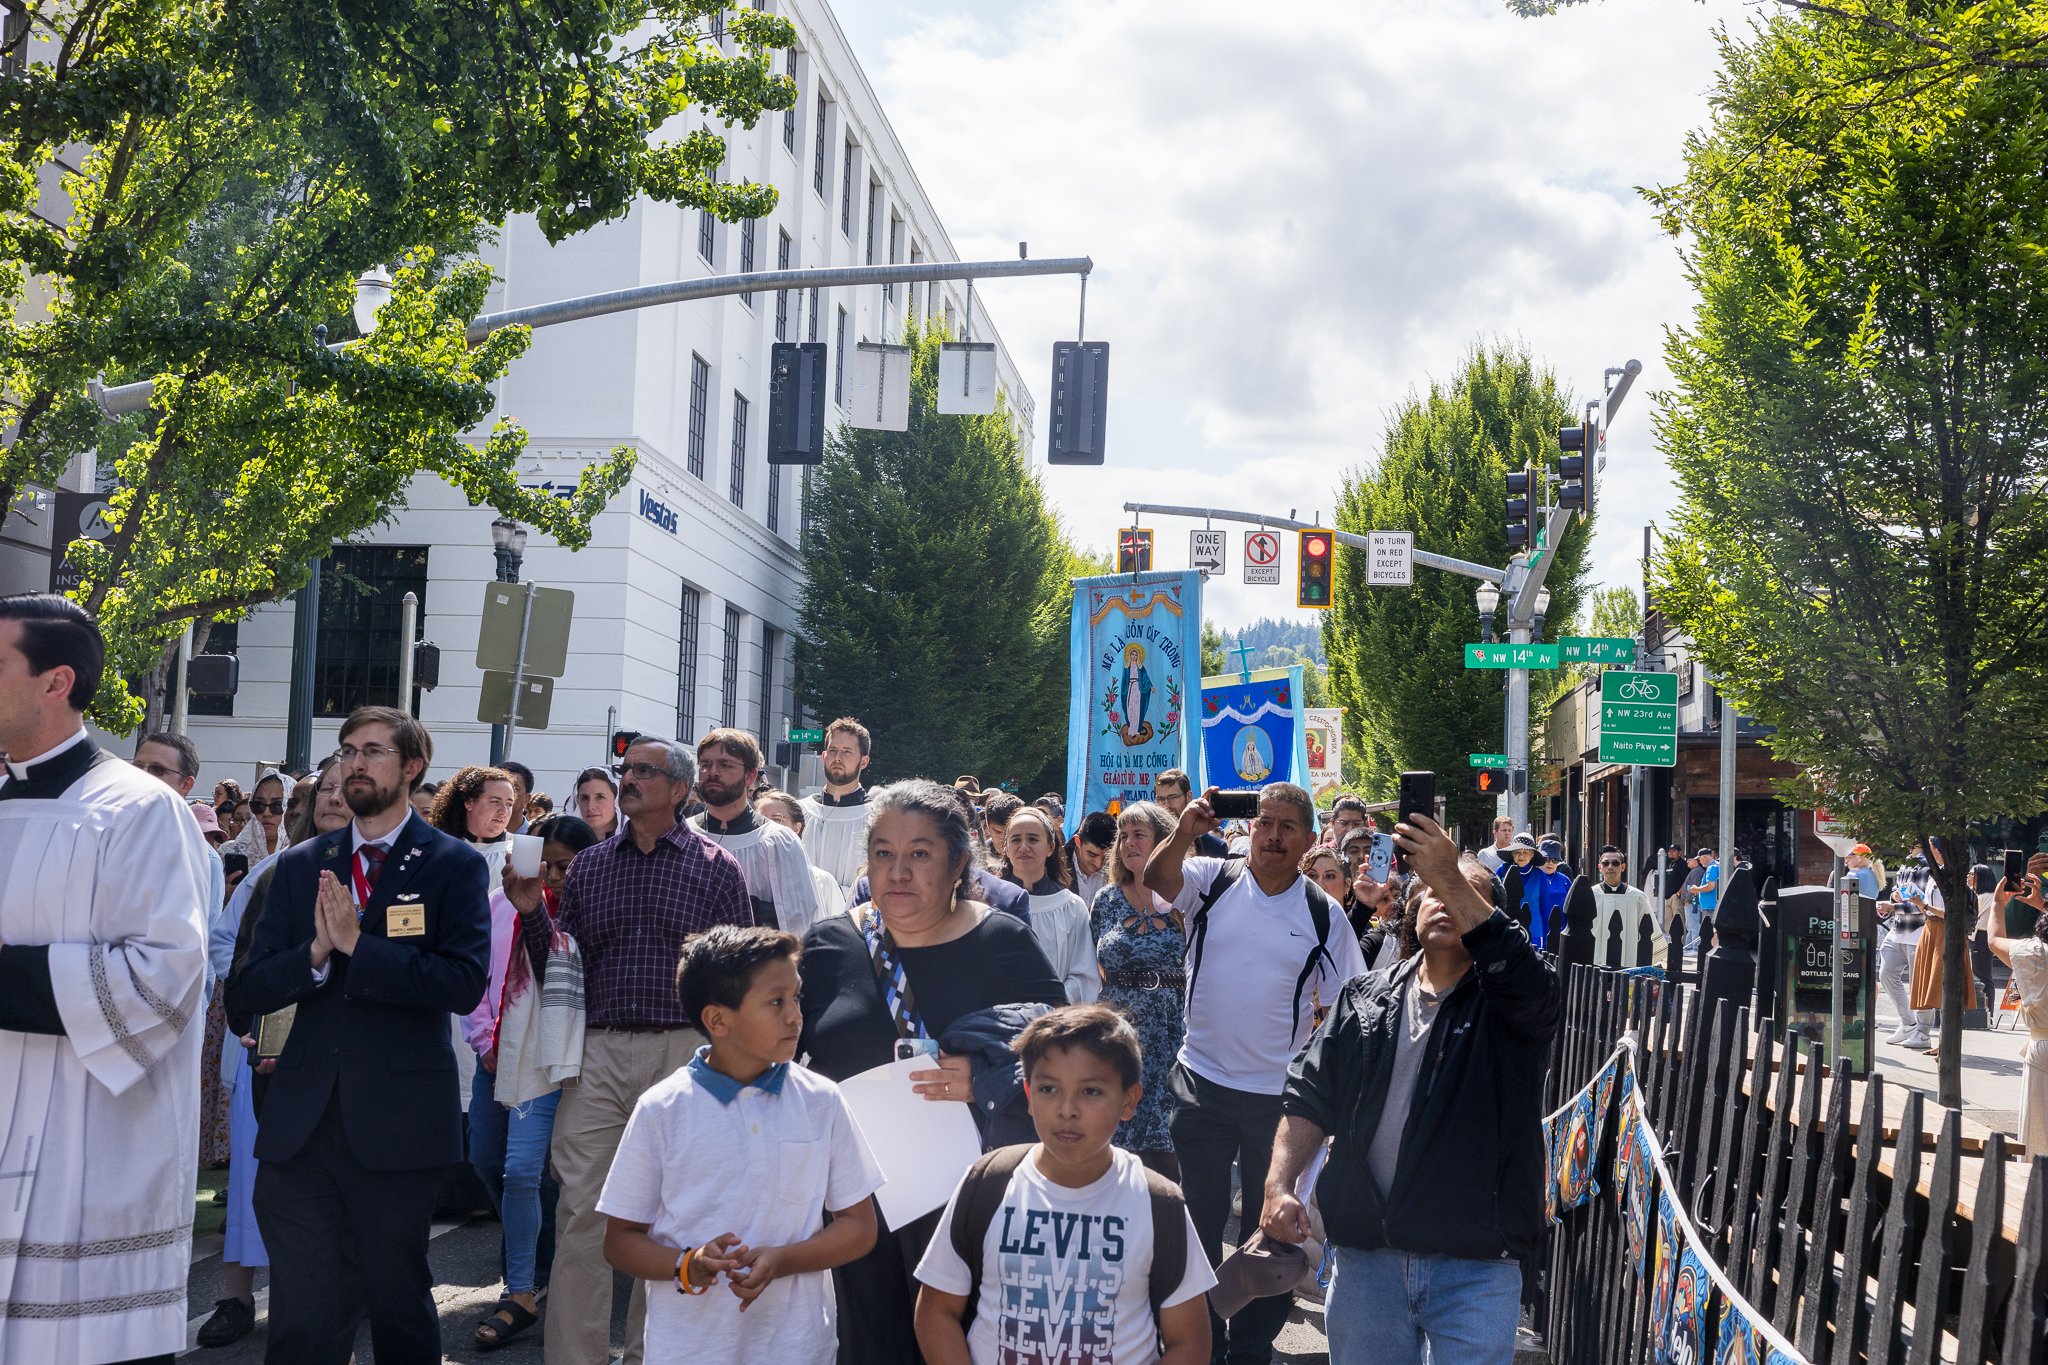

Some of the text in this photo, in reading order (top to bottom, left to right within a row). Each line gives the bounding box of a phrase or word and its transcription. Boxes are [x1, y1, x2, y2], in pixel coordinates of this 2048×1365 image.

[640, 488, 679, 535] Vestas
[1196, 534, 1220, 545] ONE
[1374, 537, 1406, 545] NO TURN
[1195, 546, 1220, 556] WAY
[1389, 549, 1403, 557] RED
[1376, 560, 1403, 568] EXCEPT
[1373, 571, 1406, 579] BICYCLES
[1566, 643, 1627, 658] NW 14th Av
[1493, 650, 1550, 664] NW 14th Av
[1617, 709, 1672, 719] NW 23rd Ave
[1613, 741, 1657, 752] Naito Pkwy
[999, 1206, 1124, 1262] LEVI'S
